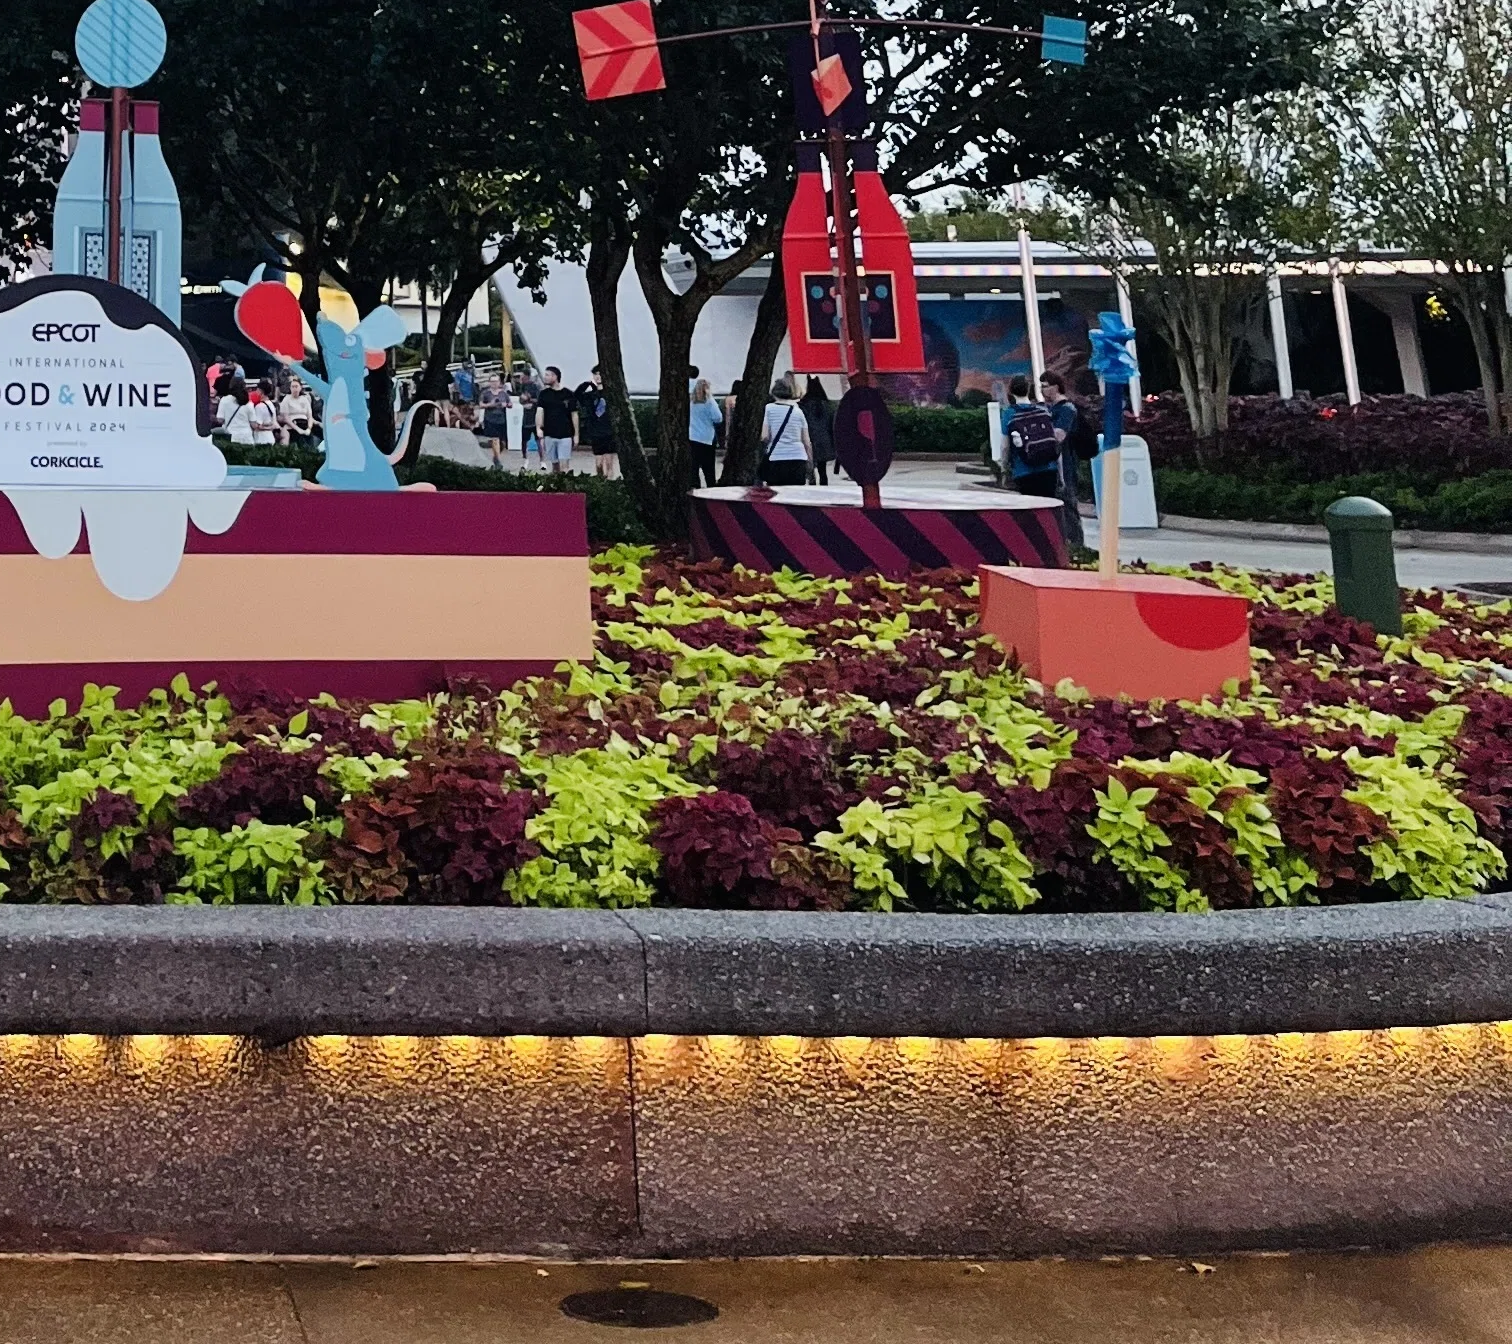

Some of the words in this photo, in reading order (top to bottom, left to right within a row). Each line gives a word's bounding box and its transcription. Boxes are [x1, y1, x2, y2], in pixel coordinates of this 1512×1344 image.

[32, 323, 101, 343] EPCOT
[9, 357, 125, 369] INTERNATIONAL
[58, 384, 76, 405] &
[83, 382, 172, 408] WINE
[4, 421, 82, 433] FESTIVAL
[89, 422, 126, 433] 2024
